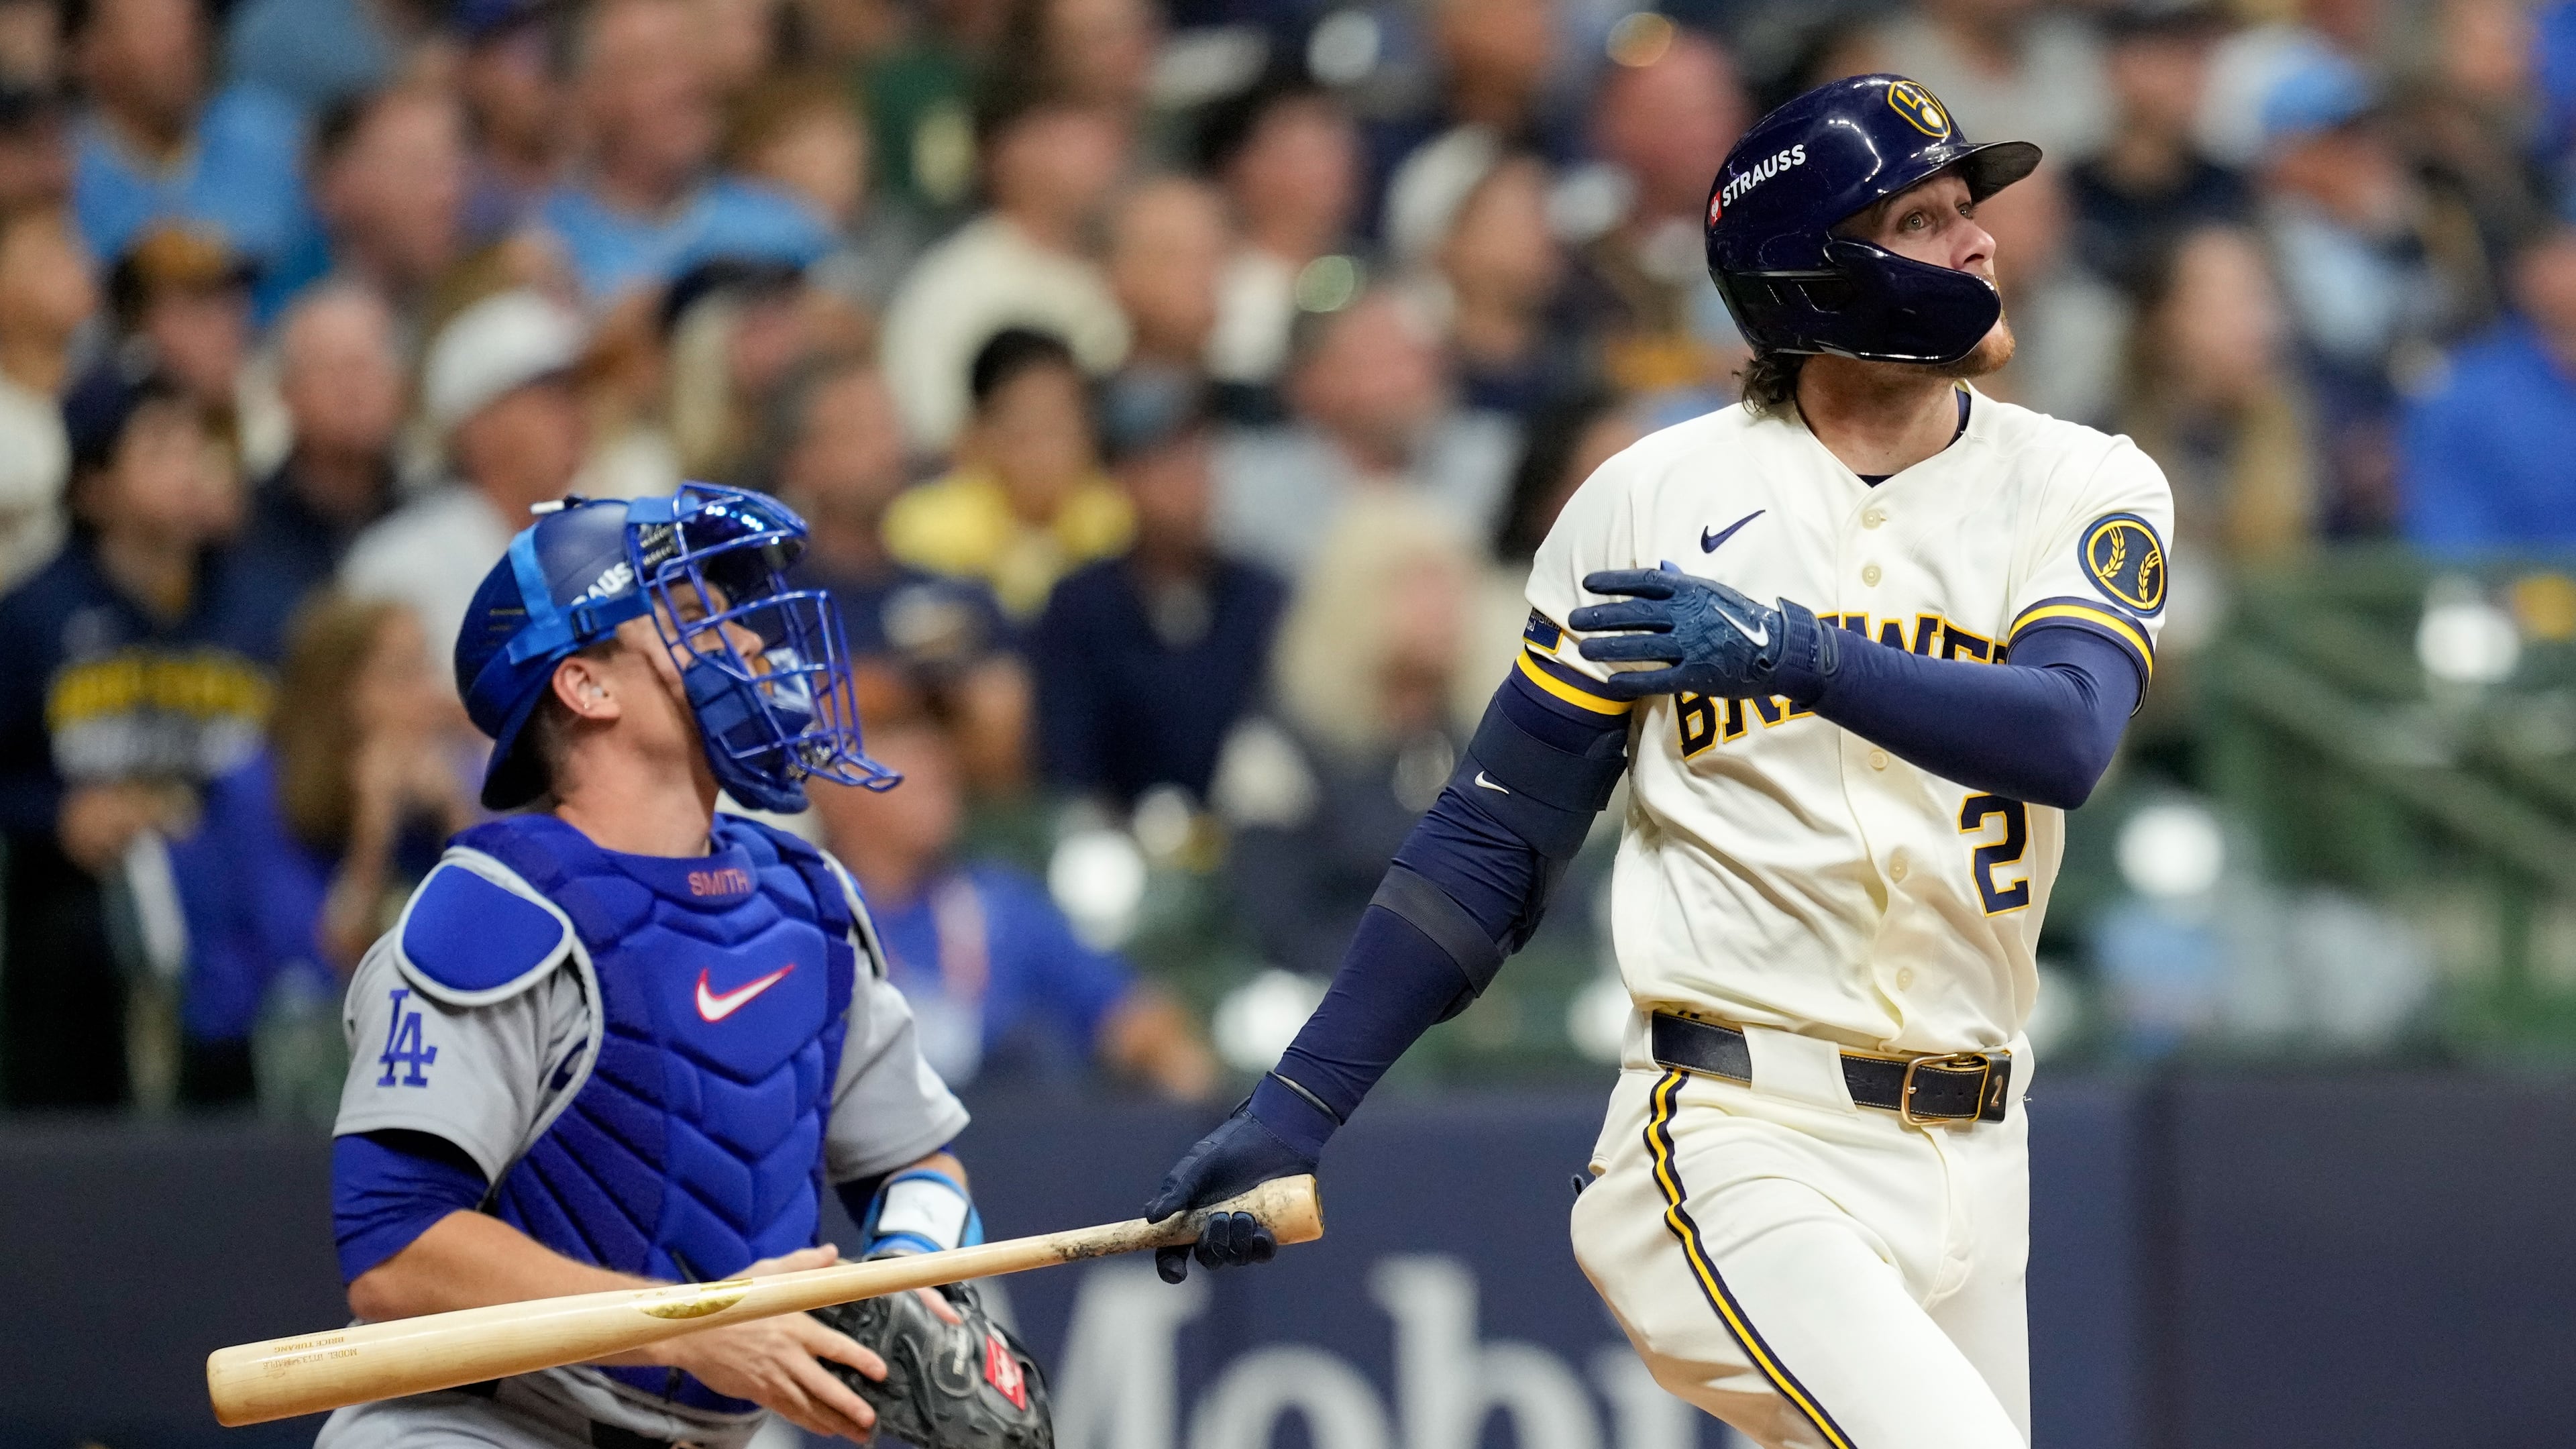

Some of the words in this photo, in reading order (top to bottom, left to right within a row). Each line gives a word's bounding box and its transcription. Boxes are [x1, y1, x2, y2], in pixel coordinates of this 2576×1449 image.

[1722, 144, 1807, 207] STRAUSS
[1957, 791, 2031, 918] 2
[688, 867, 753, 897] SMITH
[376, 989, 438, 1089] LA
[1990, 1074, 2004, 1108] 2
[274, 1342, 313, 1353] TURANG
[316, 1336, 345, 1346] BRICE
[327, 1348, 358, 1360] MODEL
